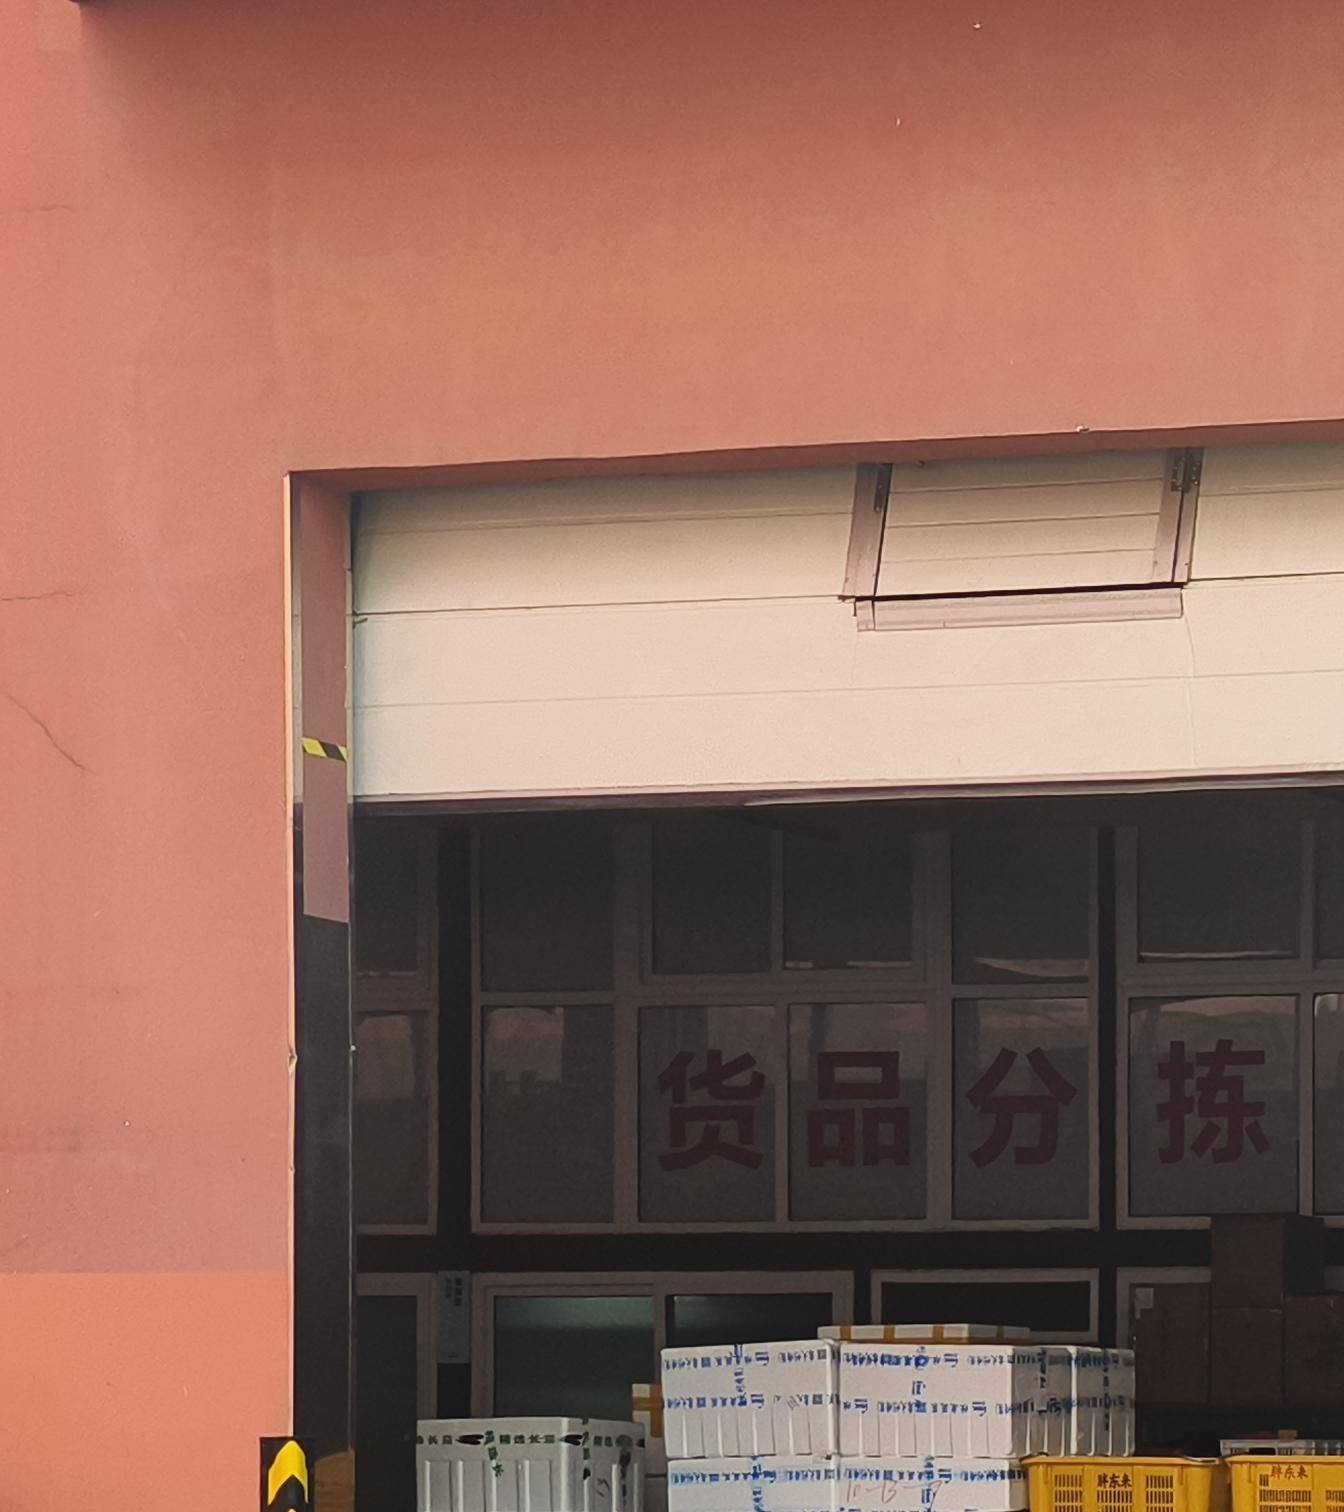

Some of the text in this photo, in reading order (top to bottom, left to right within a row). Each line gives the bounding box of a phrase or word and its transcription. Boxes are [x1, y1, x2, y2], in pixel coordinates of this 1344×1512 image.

[1270, 1464, 1309, 1479] 胖东来
[1097, 1473, 1133, 1488] 胖东来
